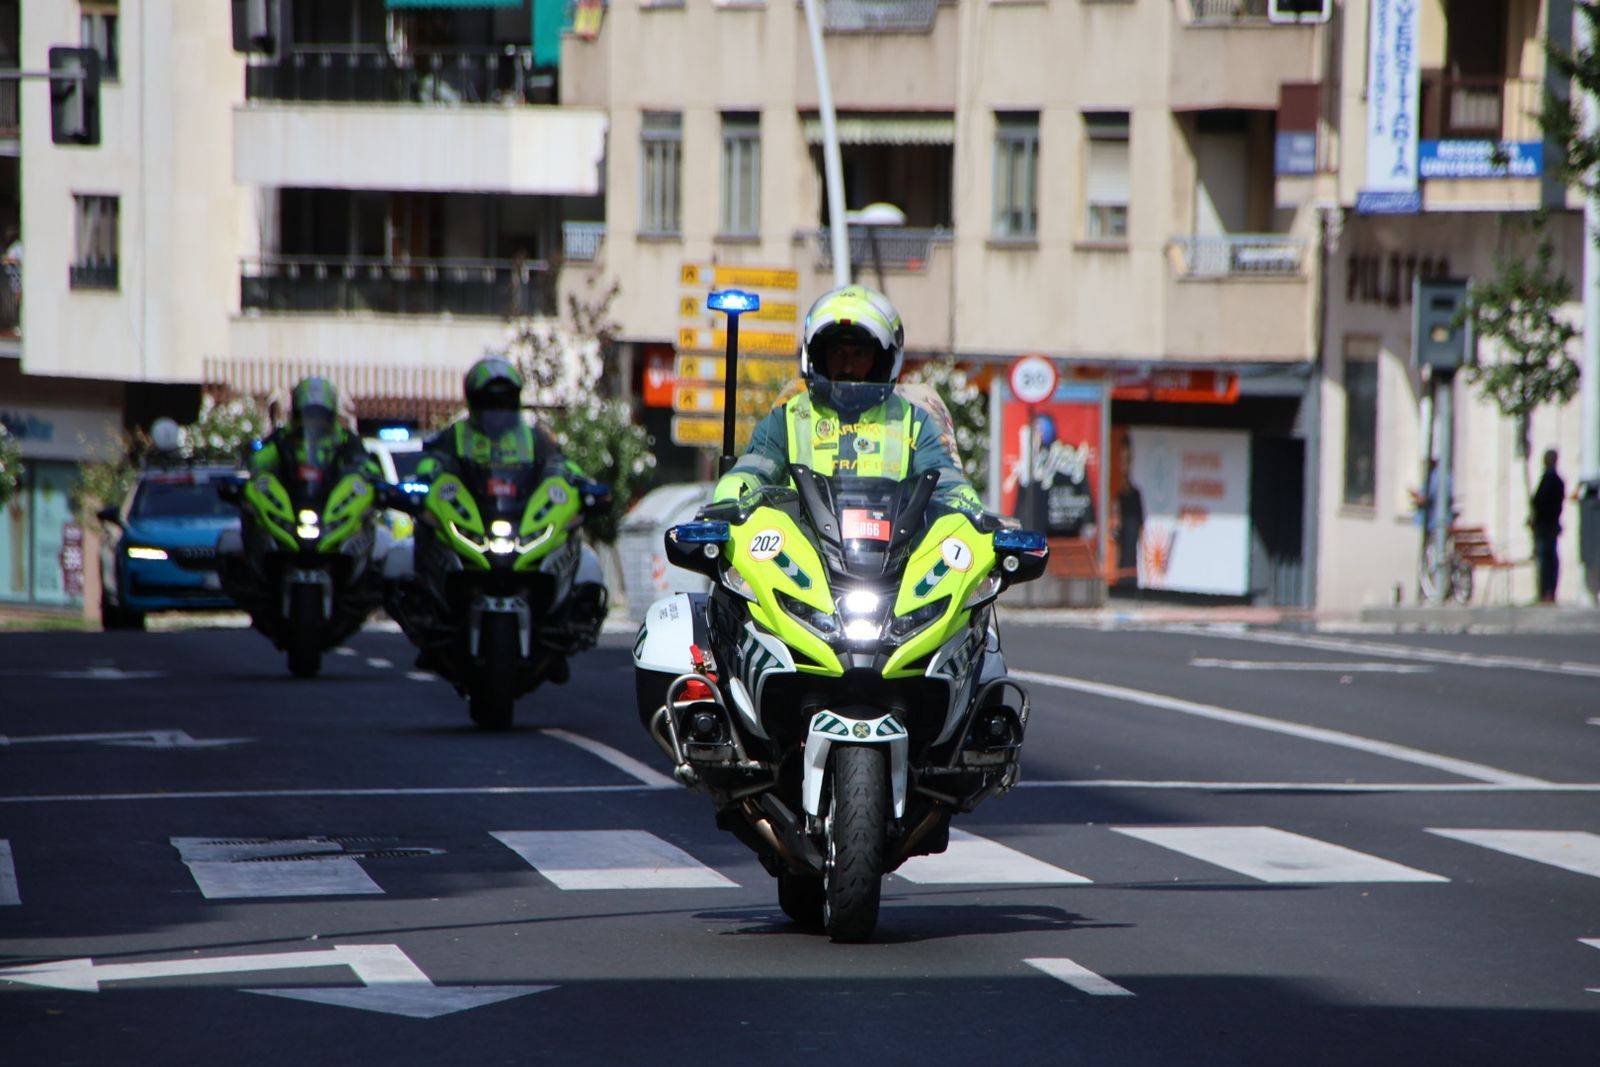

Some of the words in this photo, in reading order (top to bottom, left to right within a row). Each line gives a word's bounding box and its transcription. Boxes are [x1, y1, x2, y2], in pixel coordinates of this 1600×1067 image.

[1437, 140, 1520, 159] RESIDENA
[751, 535, 780, 552] 202
[953, 544, 962, 561] 7
